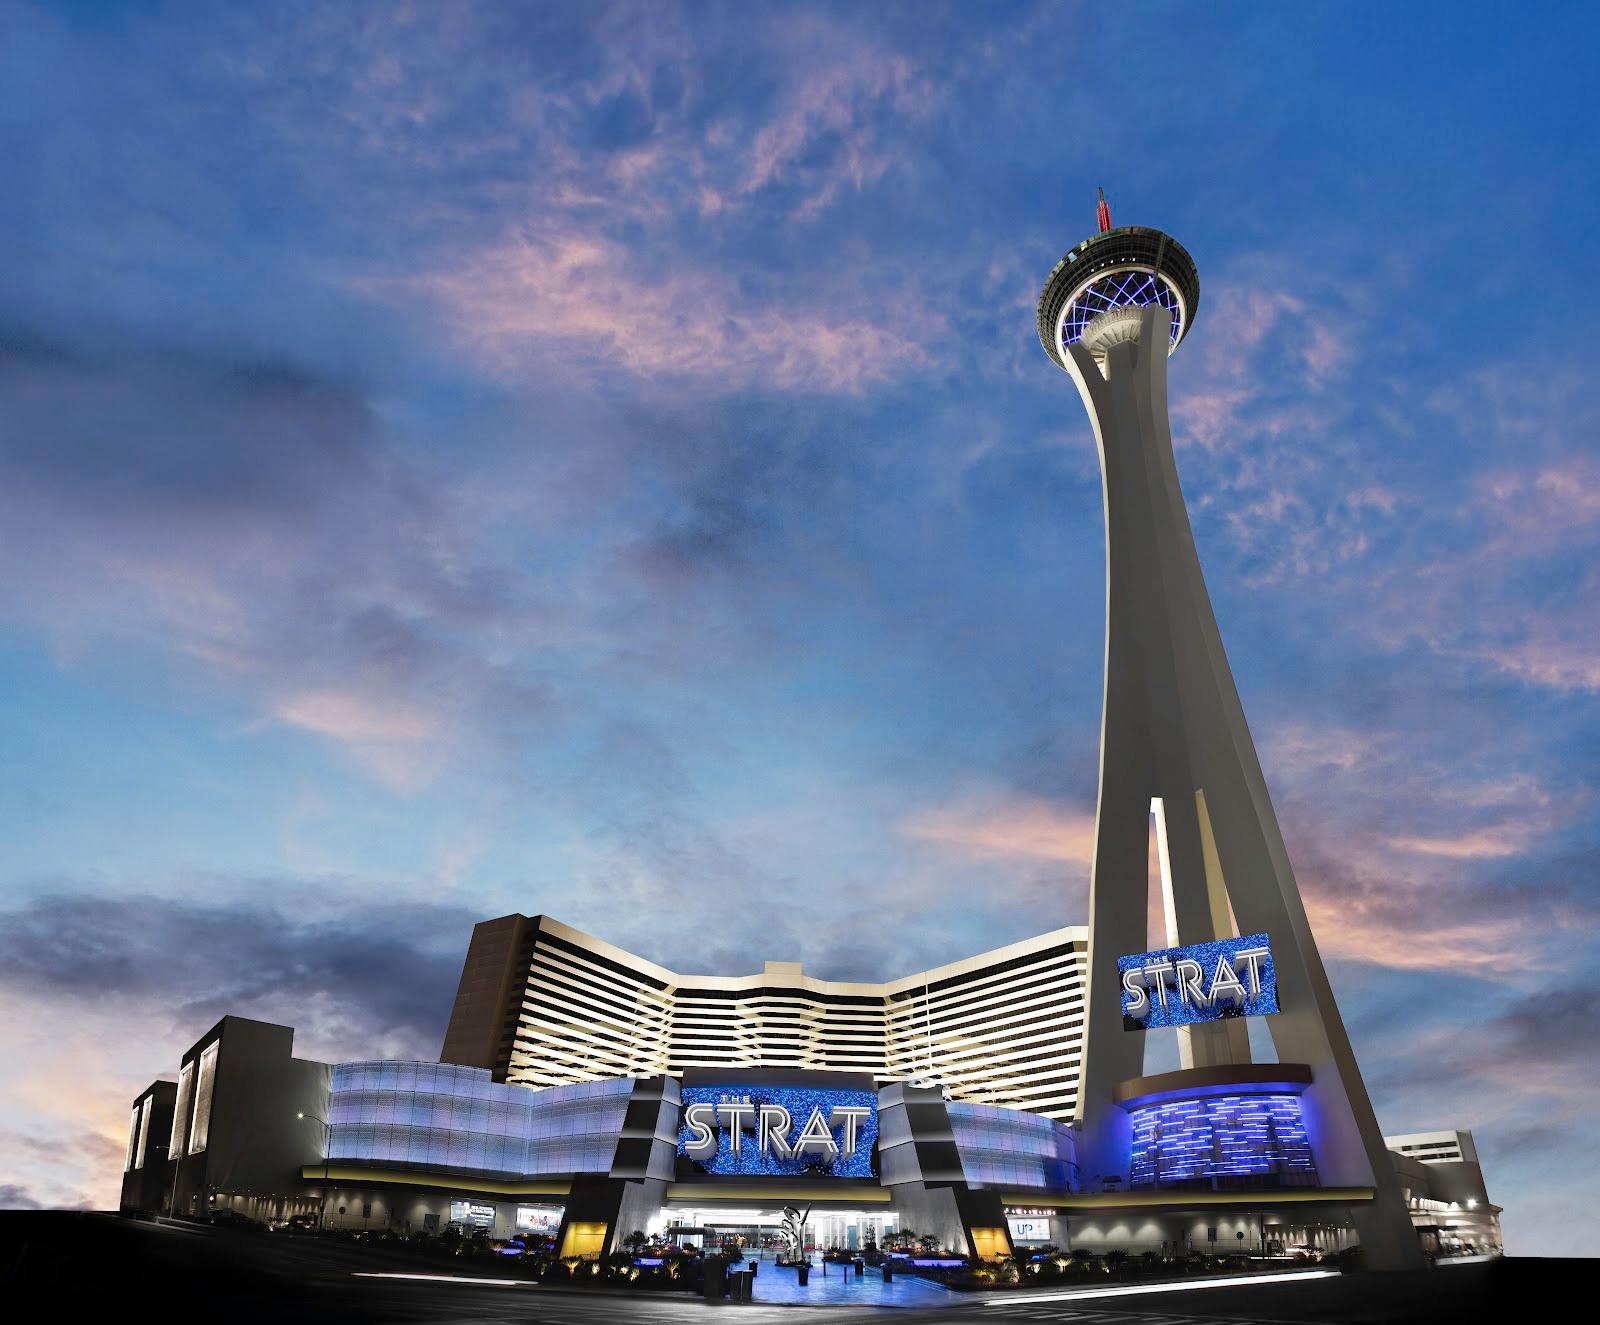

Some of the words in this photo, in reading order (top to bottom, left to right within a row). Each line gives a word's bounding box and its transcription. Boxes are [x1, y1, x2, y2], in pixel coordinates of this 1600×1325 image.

[1146, 956, 1168, 964] THE
[1123, 947, 1269, 1012] STRAT
[720, 1095, 750, 1104] THE
[684, 1103, 871, 1153] STRAT
